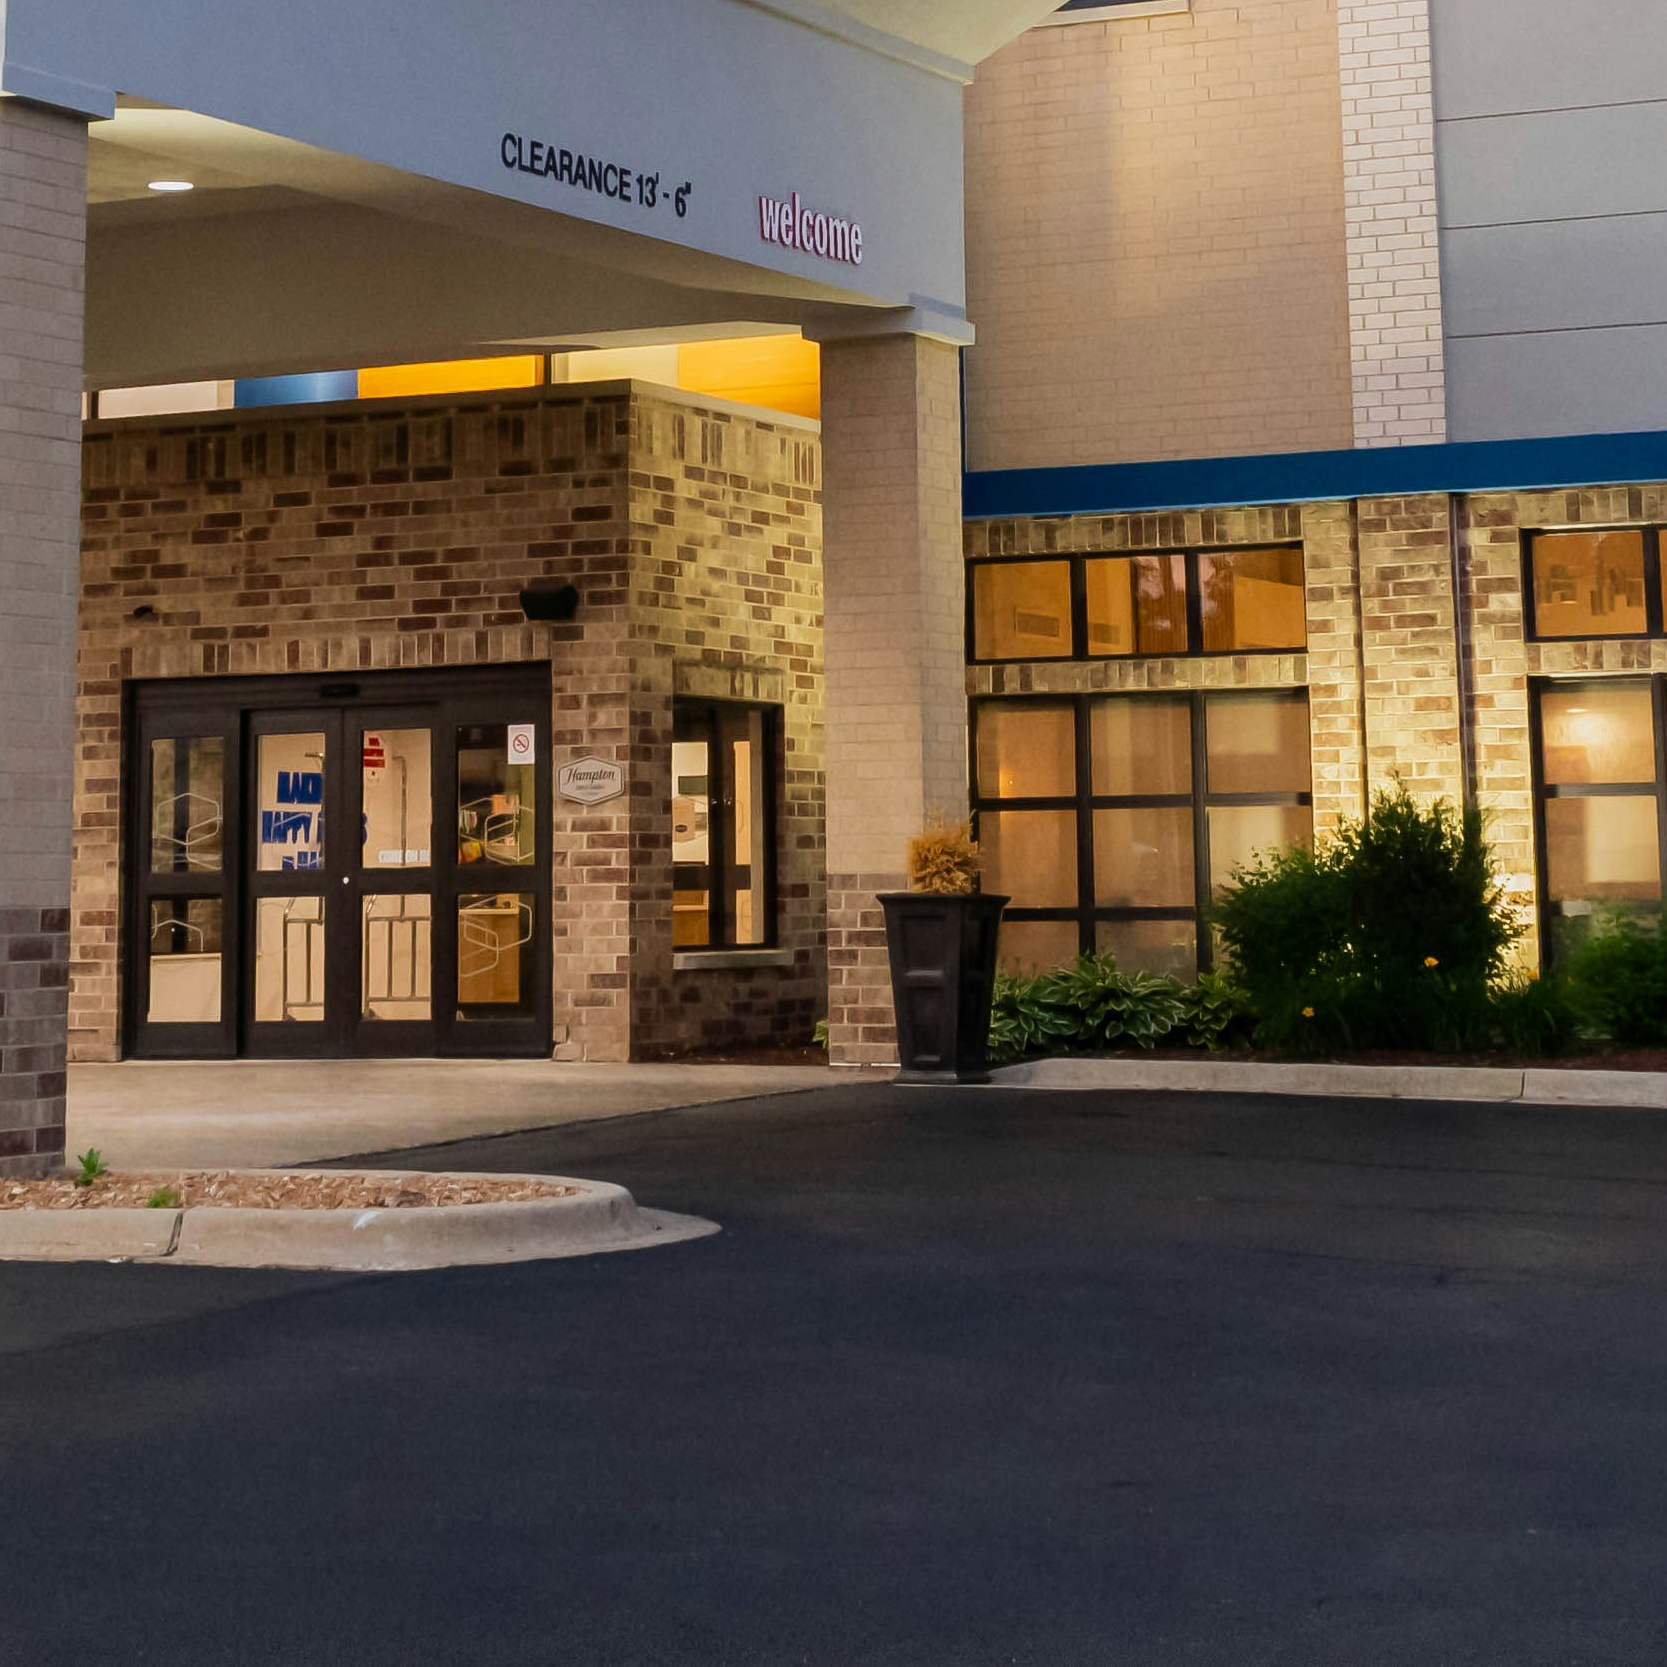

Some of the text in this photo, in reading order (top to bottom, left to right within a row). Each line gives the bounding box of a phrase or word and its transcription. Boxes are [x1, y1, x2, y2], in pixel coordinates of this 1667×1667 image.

[501, 133, 632, 203] CLEARANCE
[758, 191, 863, 266] welcome
[562, 767, 618, 785] Hampton
